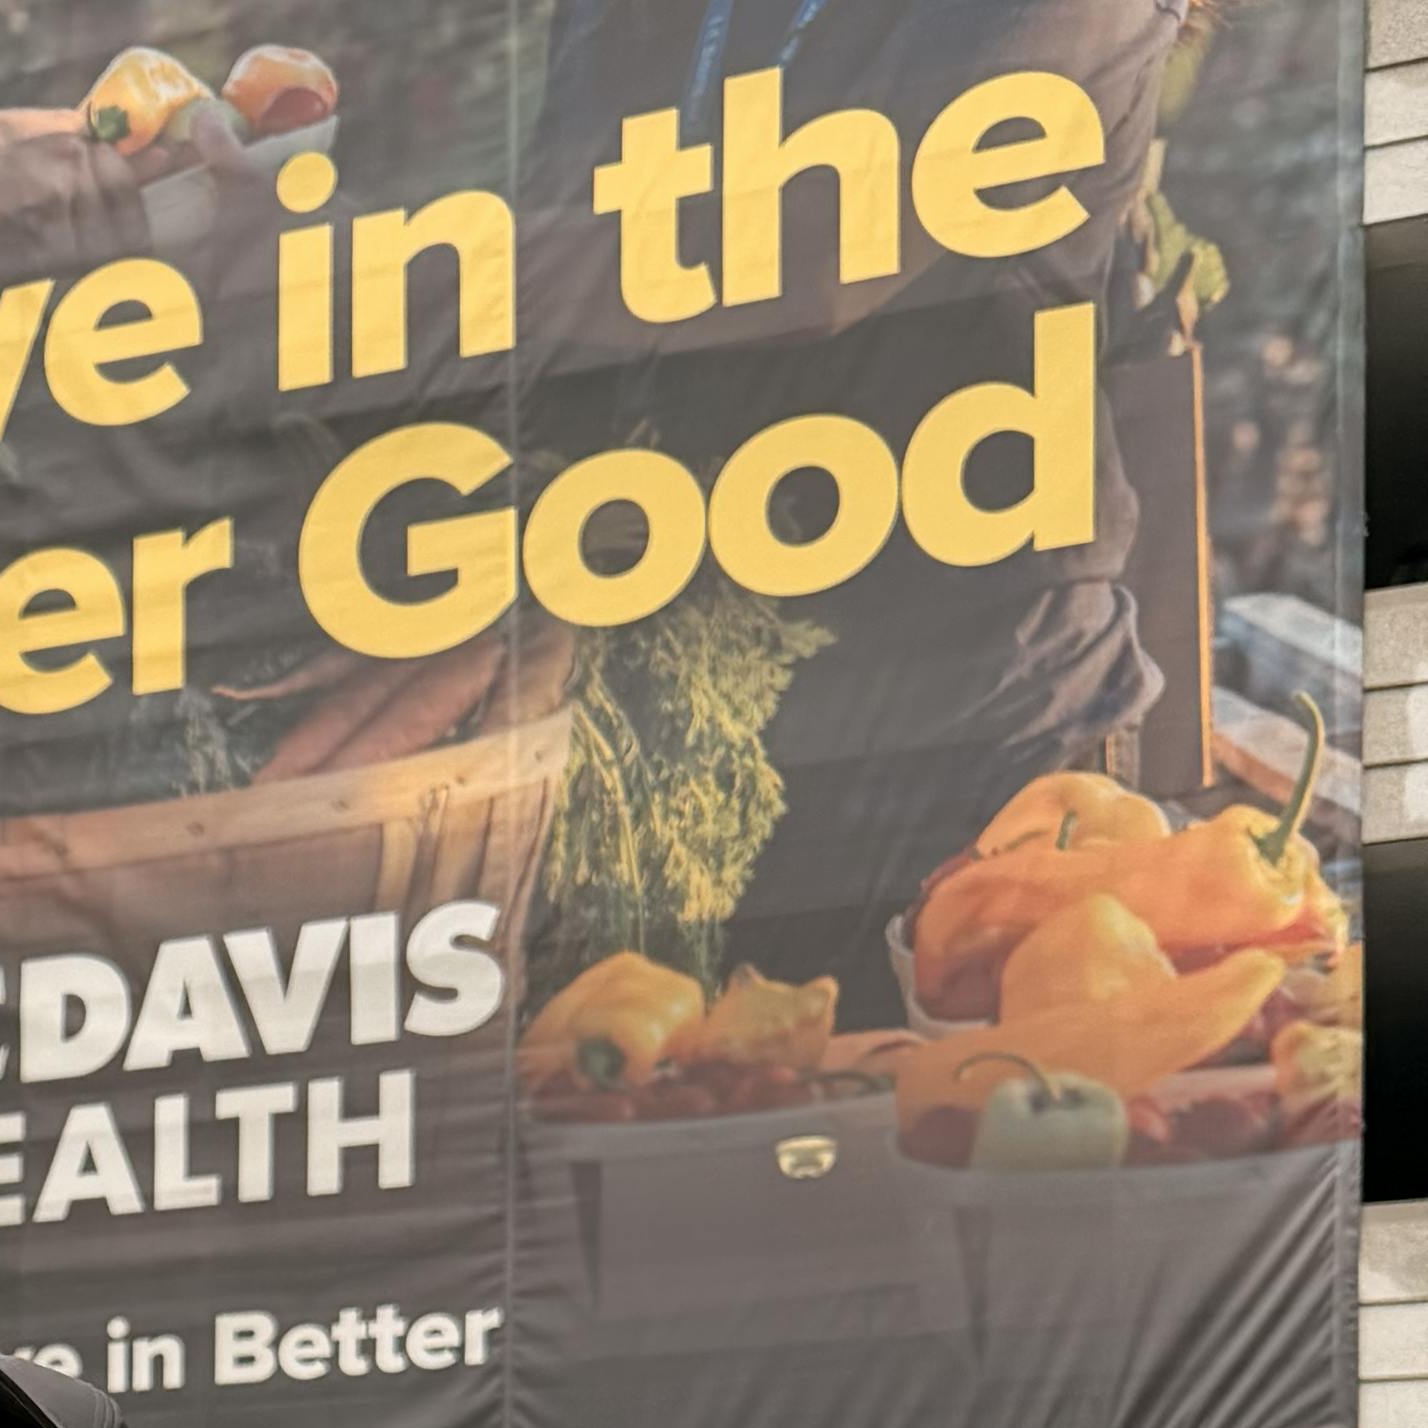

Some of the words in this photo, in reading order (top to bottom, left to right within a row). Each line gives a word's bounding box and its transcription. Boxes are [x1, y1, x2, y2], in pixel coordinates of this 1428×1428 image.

[276, 151, 516, 392] in
[593, 66, 1107, 324] the
[298, 302, 1097, 659] Good
[106, 1316, 185, 1394] in
[214, 1304, 503, 1386] Better
